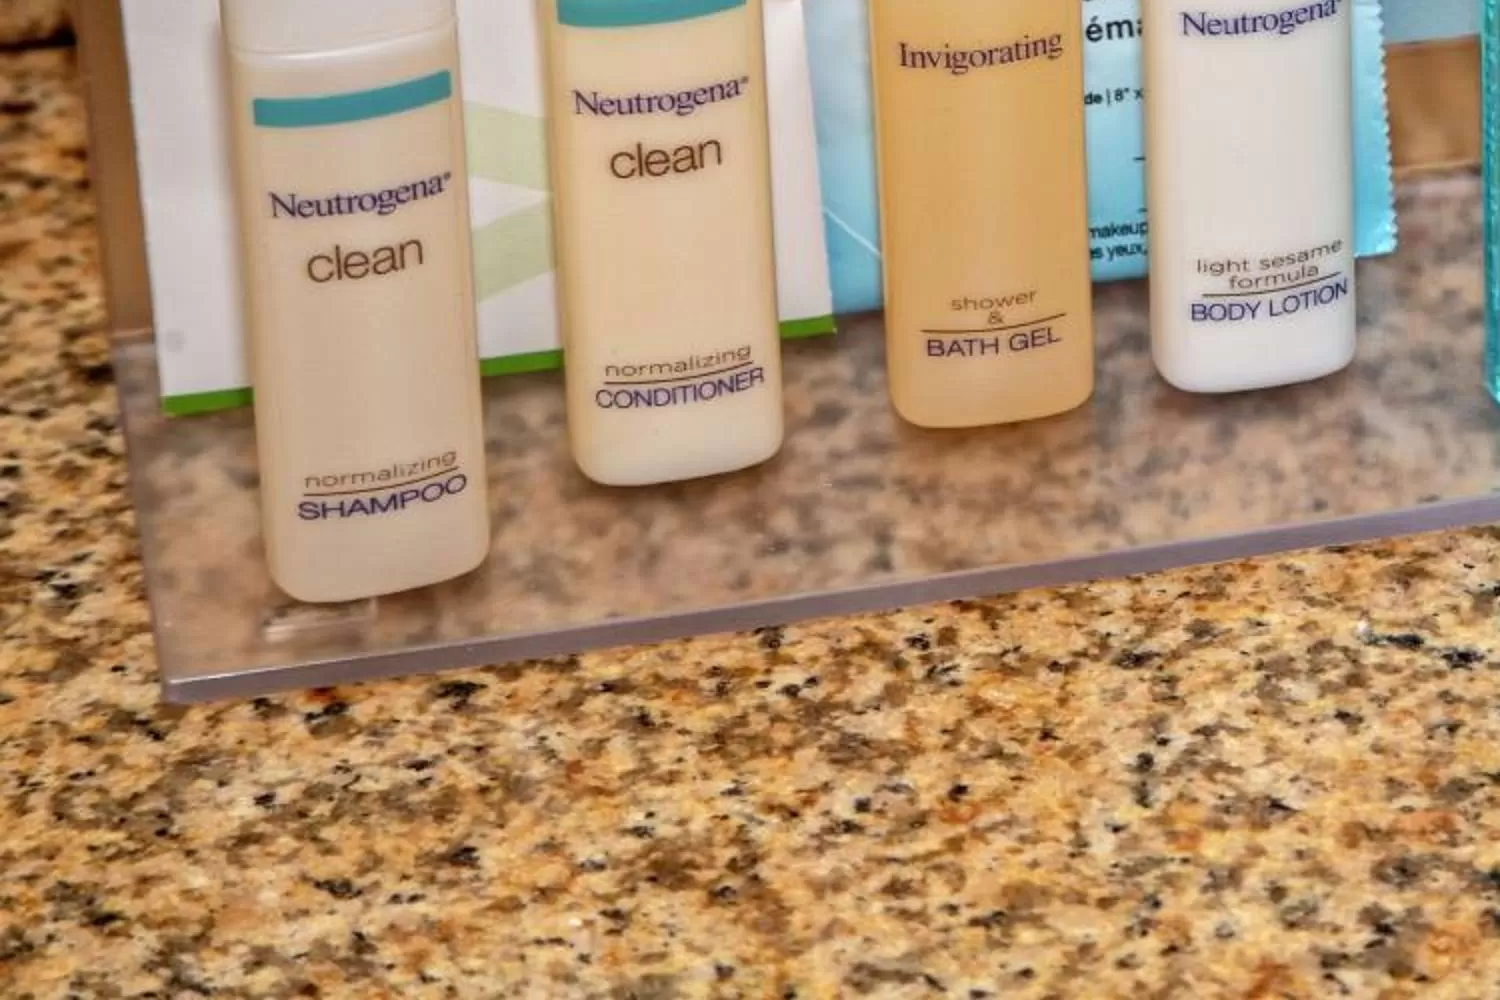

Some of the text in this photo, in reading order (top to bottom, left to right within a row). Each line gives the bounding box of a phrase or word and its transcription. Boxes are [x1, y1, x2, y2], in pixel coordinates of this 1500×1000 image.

[899, 34, 1063, 75] Invigorating
[610, 139, 723, 179] clean
[307, 238, 423, 283] clean
[1197, 239, 1343, 277] light sesame
[1229, 265, 1319, 289] formula
[951, 290, 1037, 312] shower
[987, 311, 1004, 325] &
[1191, 278, 1348, 321] BODY LOTION
[605, 344, 751, 377] normalizing
[927, 327, 1062, 357] BATH GEL
[595, 367, 765, 409] CONDITIONER
[304, 450, 457, 489] normalizing
[298, 473, 467, 521] SHAMPOO
